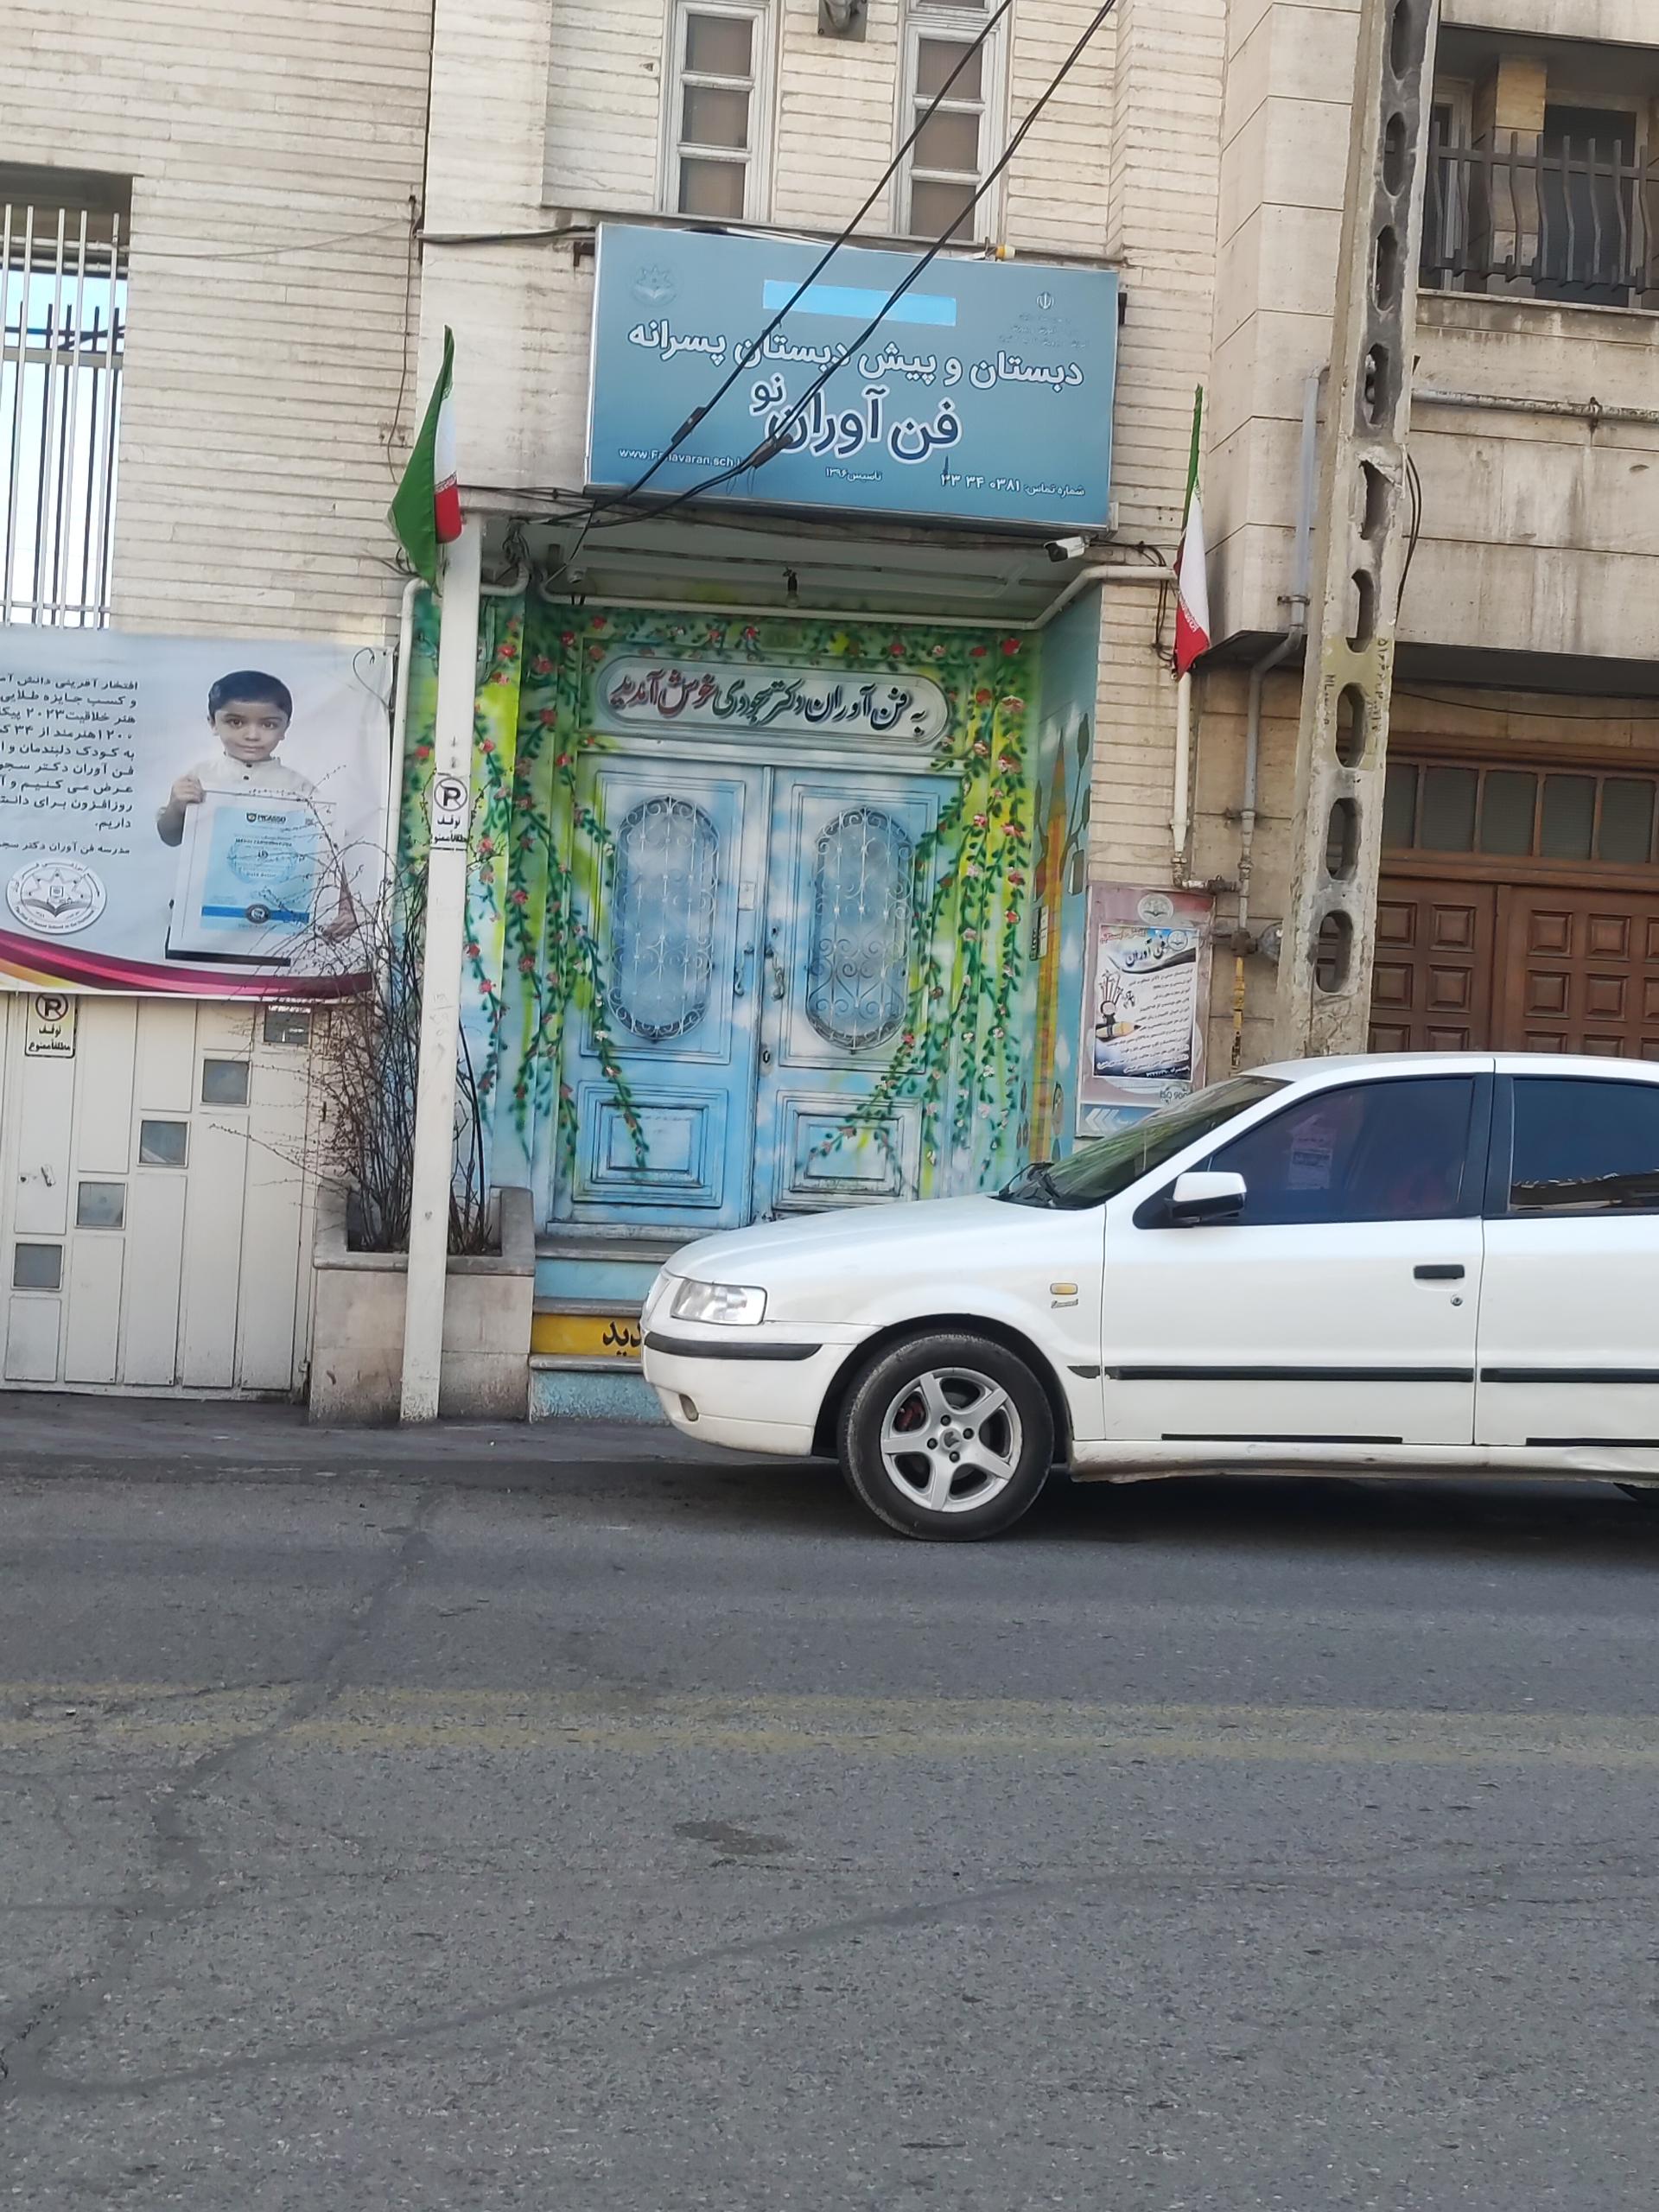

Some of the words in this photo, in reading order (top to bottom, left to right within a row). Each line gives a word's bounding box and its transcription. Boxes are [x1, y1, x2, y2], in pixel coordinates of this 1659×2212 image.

[628, 319, 726, 366] پسرانه
[734, 328, 851, 372] دبستان
[858, 341, 938, 386] پیش
[944, 356, 963, 386] و
[969, 350, 1084, 392] دبستان
[749, 372, 786, 416] نو
[766, 384, 889, 457] آوران
[889, 398, 961, 463] فن
[619, 448, 741, 467] www.Favaran.sch.i
[964, 474, 986, 490] ۳۴
[988, 478, 1020, 493] ۰۳۸۱
[1057, 484, 1085, 499] شماره
[17, 676, 51, 686] دانش
[55, 677, 99, 689] آفرینی
[102, 680, 138, 690] افتخار
[608, 668, 666, 710] آمدید
[658, 669, 717, 719] خوش
[43, 692, 83, 706] جایزه
[87, 695, 126, 708] کسب
[130, 697, 137, 709] و
[712, 679, 773, 727] سجودی
[755, 677, 805, 727] دکتر
[804, 683, 877, 724] آوران
[870, 687, 912, 731] فن
[114, 715, 136, 726] هنر
[910, 709, 927, 736] به
[39, 726, 50, 738] از
[8, 745, 16, 754] و
[19, 742, 72, 758] دلبندمان
[76, 747, 119, 760] کودک
[124, 748, 135, 760] به
[35, 761, 68, 773] دکتر
[73, 762, 107, 776] آوران
[111, 766, 134, 779] فن
[10, 780, 17, 790] و
[21, 779, 63, 792] کنیم
[67, 785, 89, 794] می
[93, 782, 133, 795] عرض
[34, 795, 67, 810] برای
[71, 797, 133, 812] روزافزون
[22, 840, 46, 851] دکتر
[48, 841, 77, 853] آوران
[79, 843, 94, 855] فن
[98, 844, 130, 855] مدرسه
